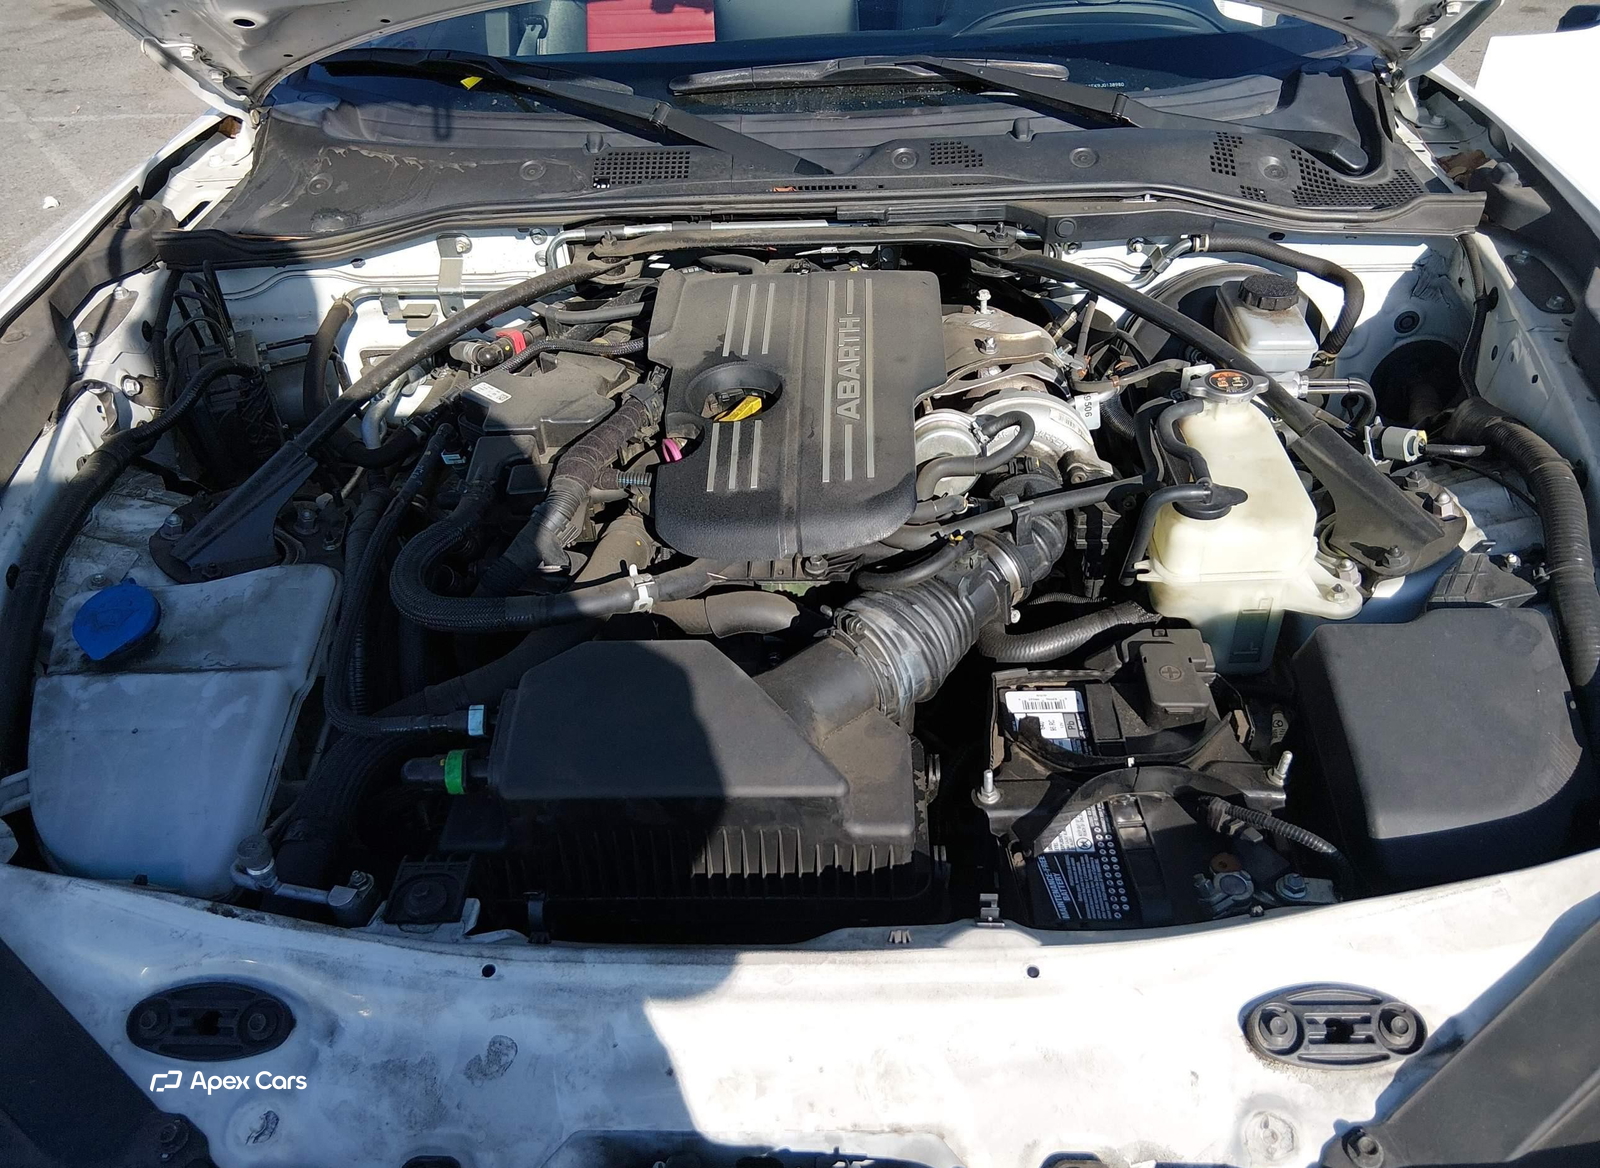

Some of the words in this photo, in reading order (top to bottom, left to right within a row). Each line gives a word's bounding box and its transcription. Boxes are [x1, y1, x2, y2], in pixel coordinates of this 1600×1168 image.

[836, 317, 861, 420] ABARTH
[1067, 719, 1077, 731] Pb
[1038, 855, 1071, 919] MAINTENANCE-FREE
[1053, 873, 1071, 902] BATTERY
